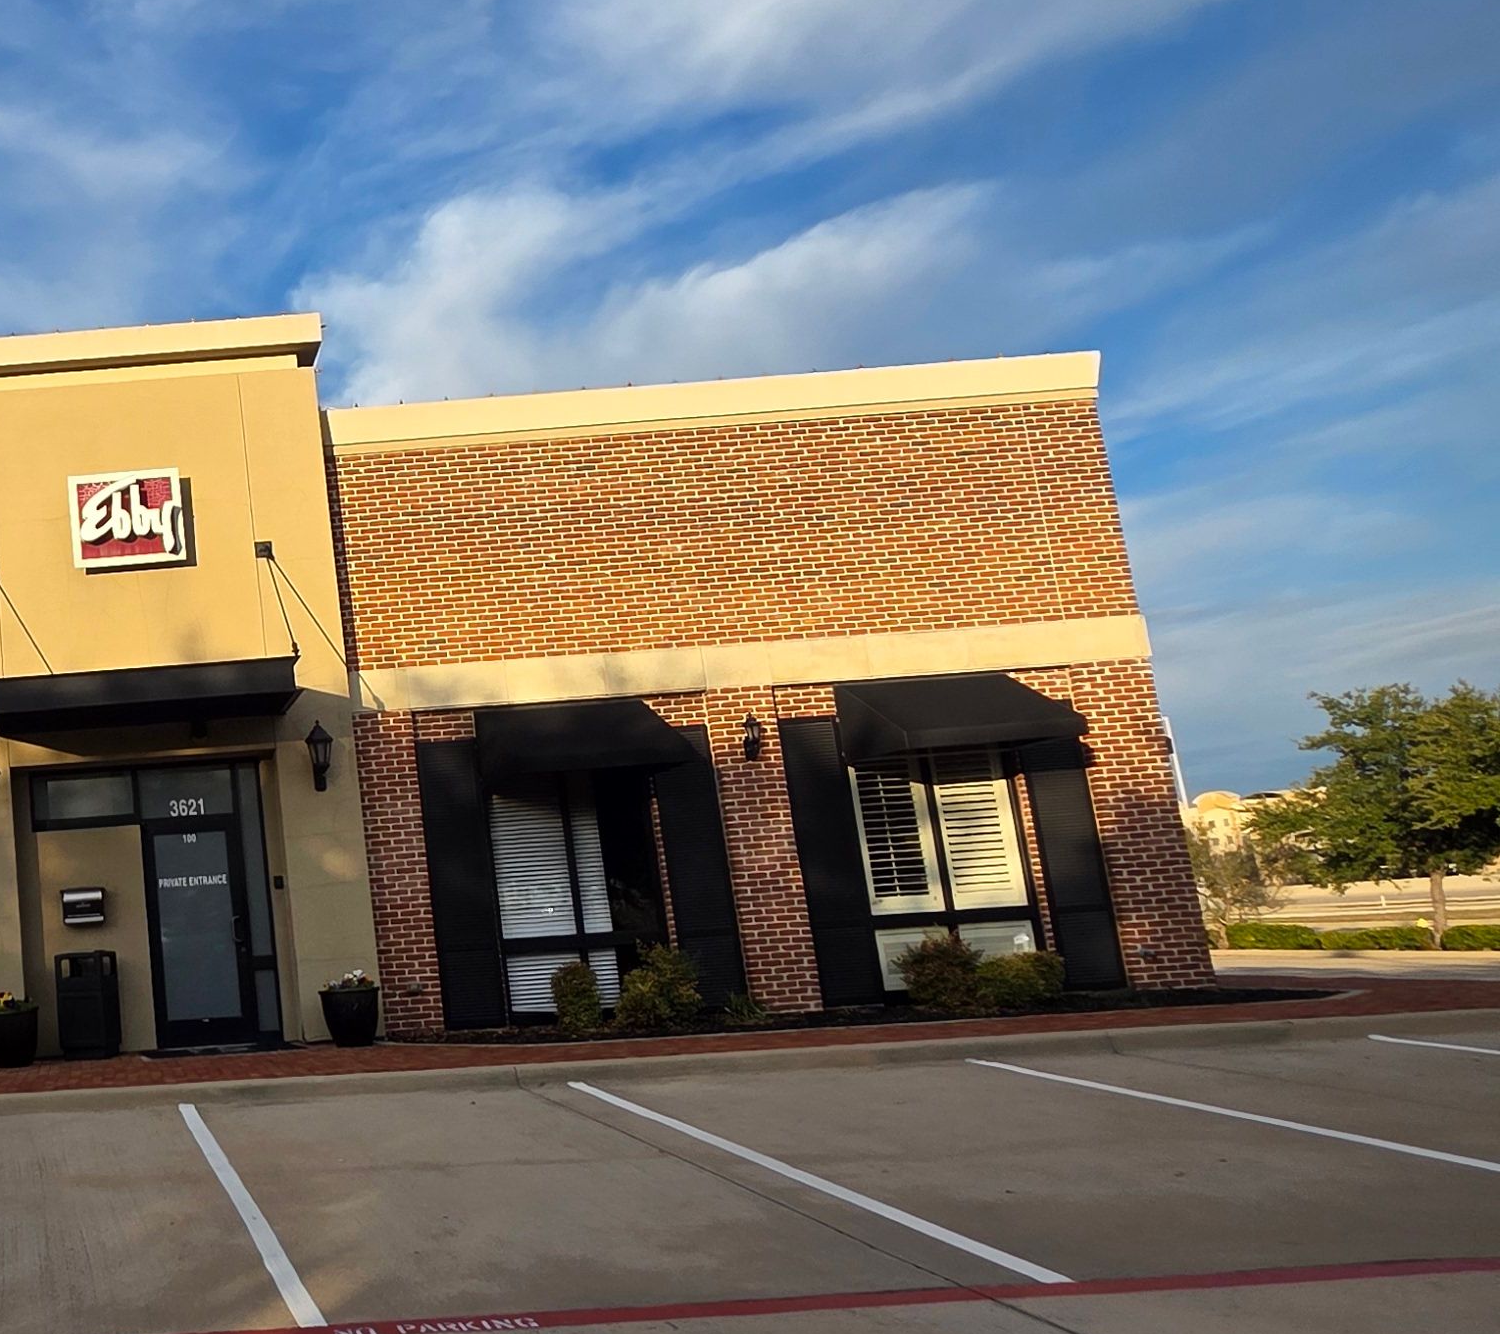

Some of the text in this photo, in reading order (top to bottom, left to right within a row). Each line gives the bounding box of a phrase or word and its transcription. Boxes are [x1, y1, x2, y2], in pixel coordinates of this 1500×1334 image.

[80, 475, 176, 554] Ebby
[169, 798, 205, 817] 3621
[182, 834, 197, 843] 100
[158, 873, 227, 888] PRIVATE ENTRANCE
[396, 1317, 540, 1334] PARKING
